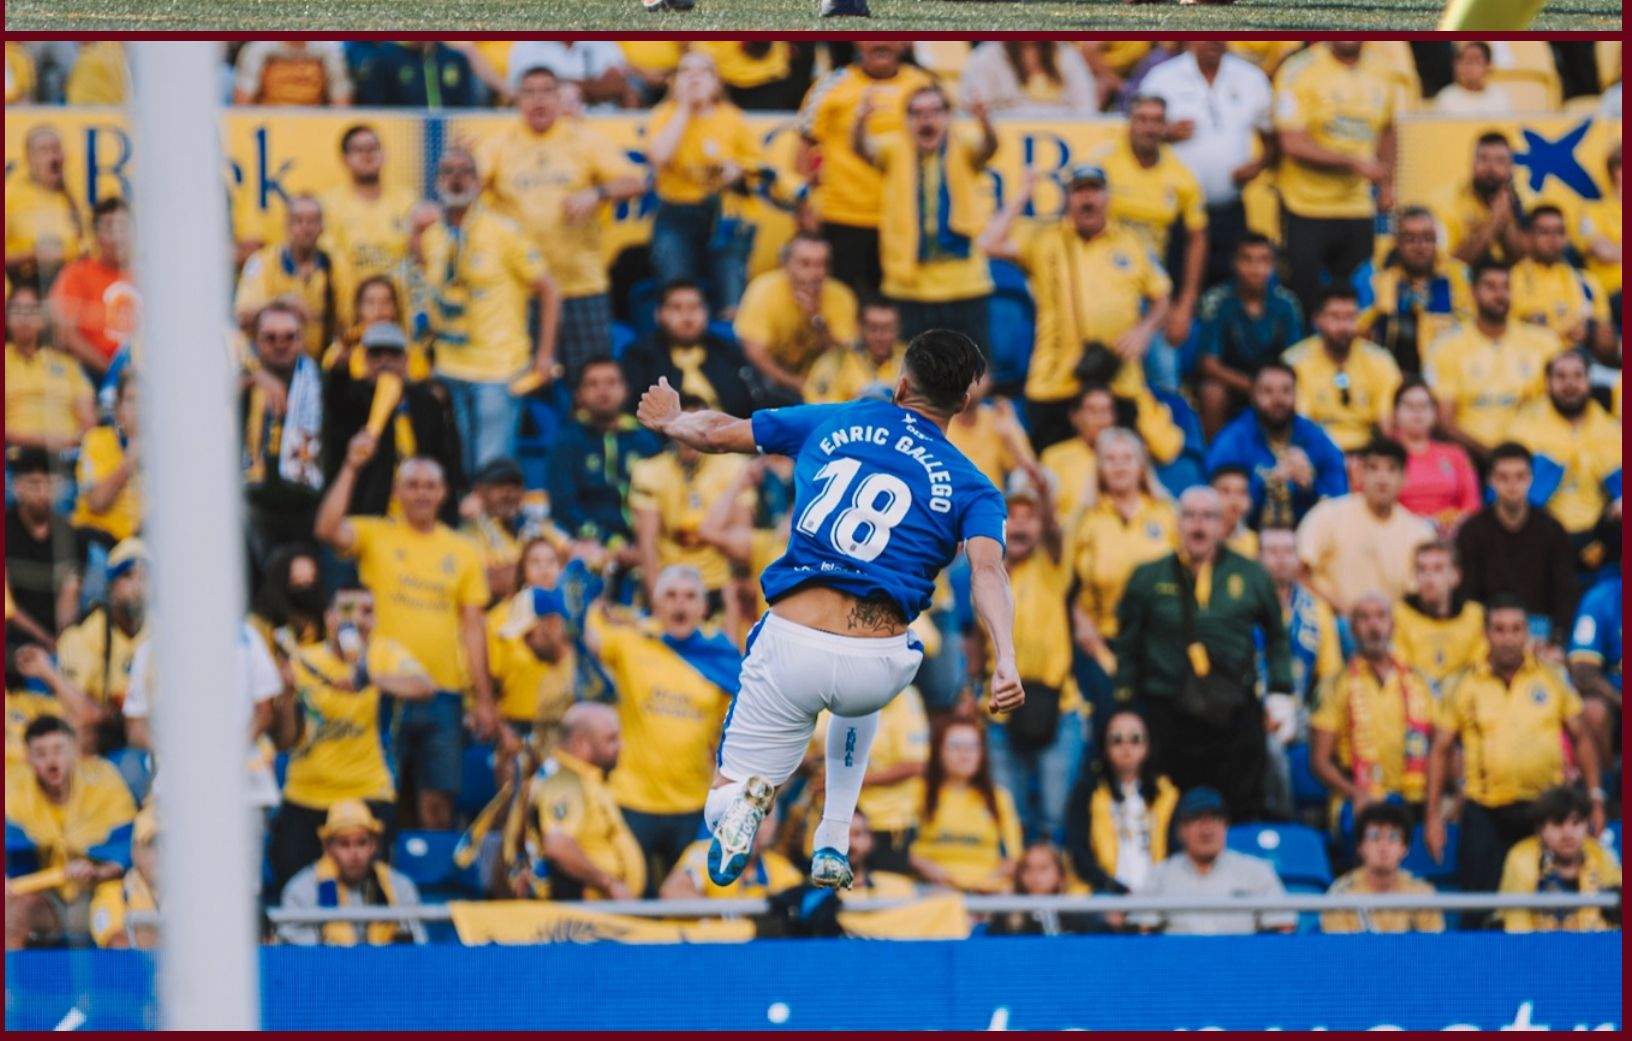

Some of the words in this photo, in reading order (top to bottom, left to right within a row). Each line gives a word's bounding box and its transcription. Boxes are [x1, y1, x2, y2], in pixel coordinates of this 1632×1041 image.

[796, 457, 912, 562] 18
[819, 425, 890, 456] ENRIC
[895, 435, 953, 514] GALLEGO
